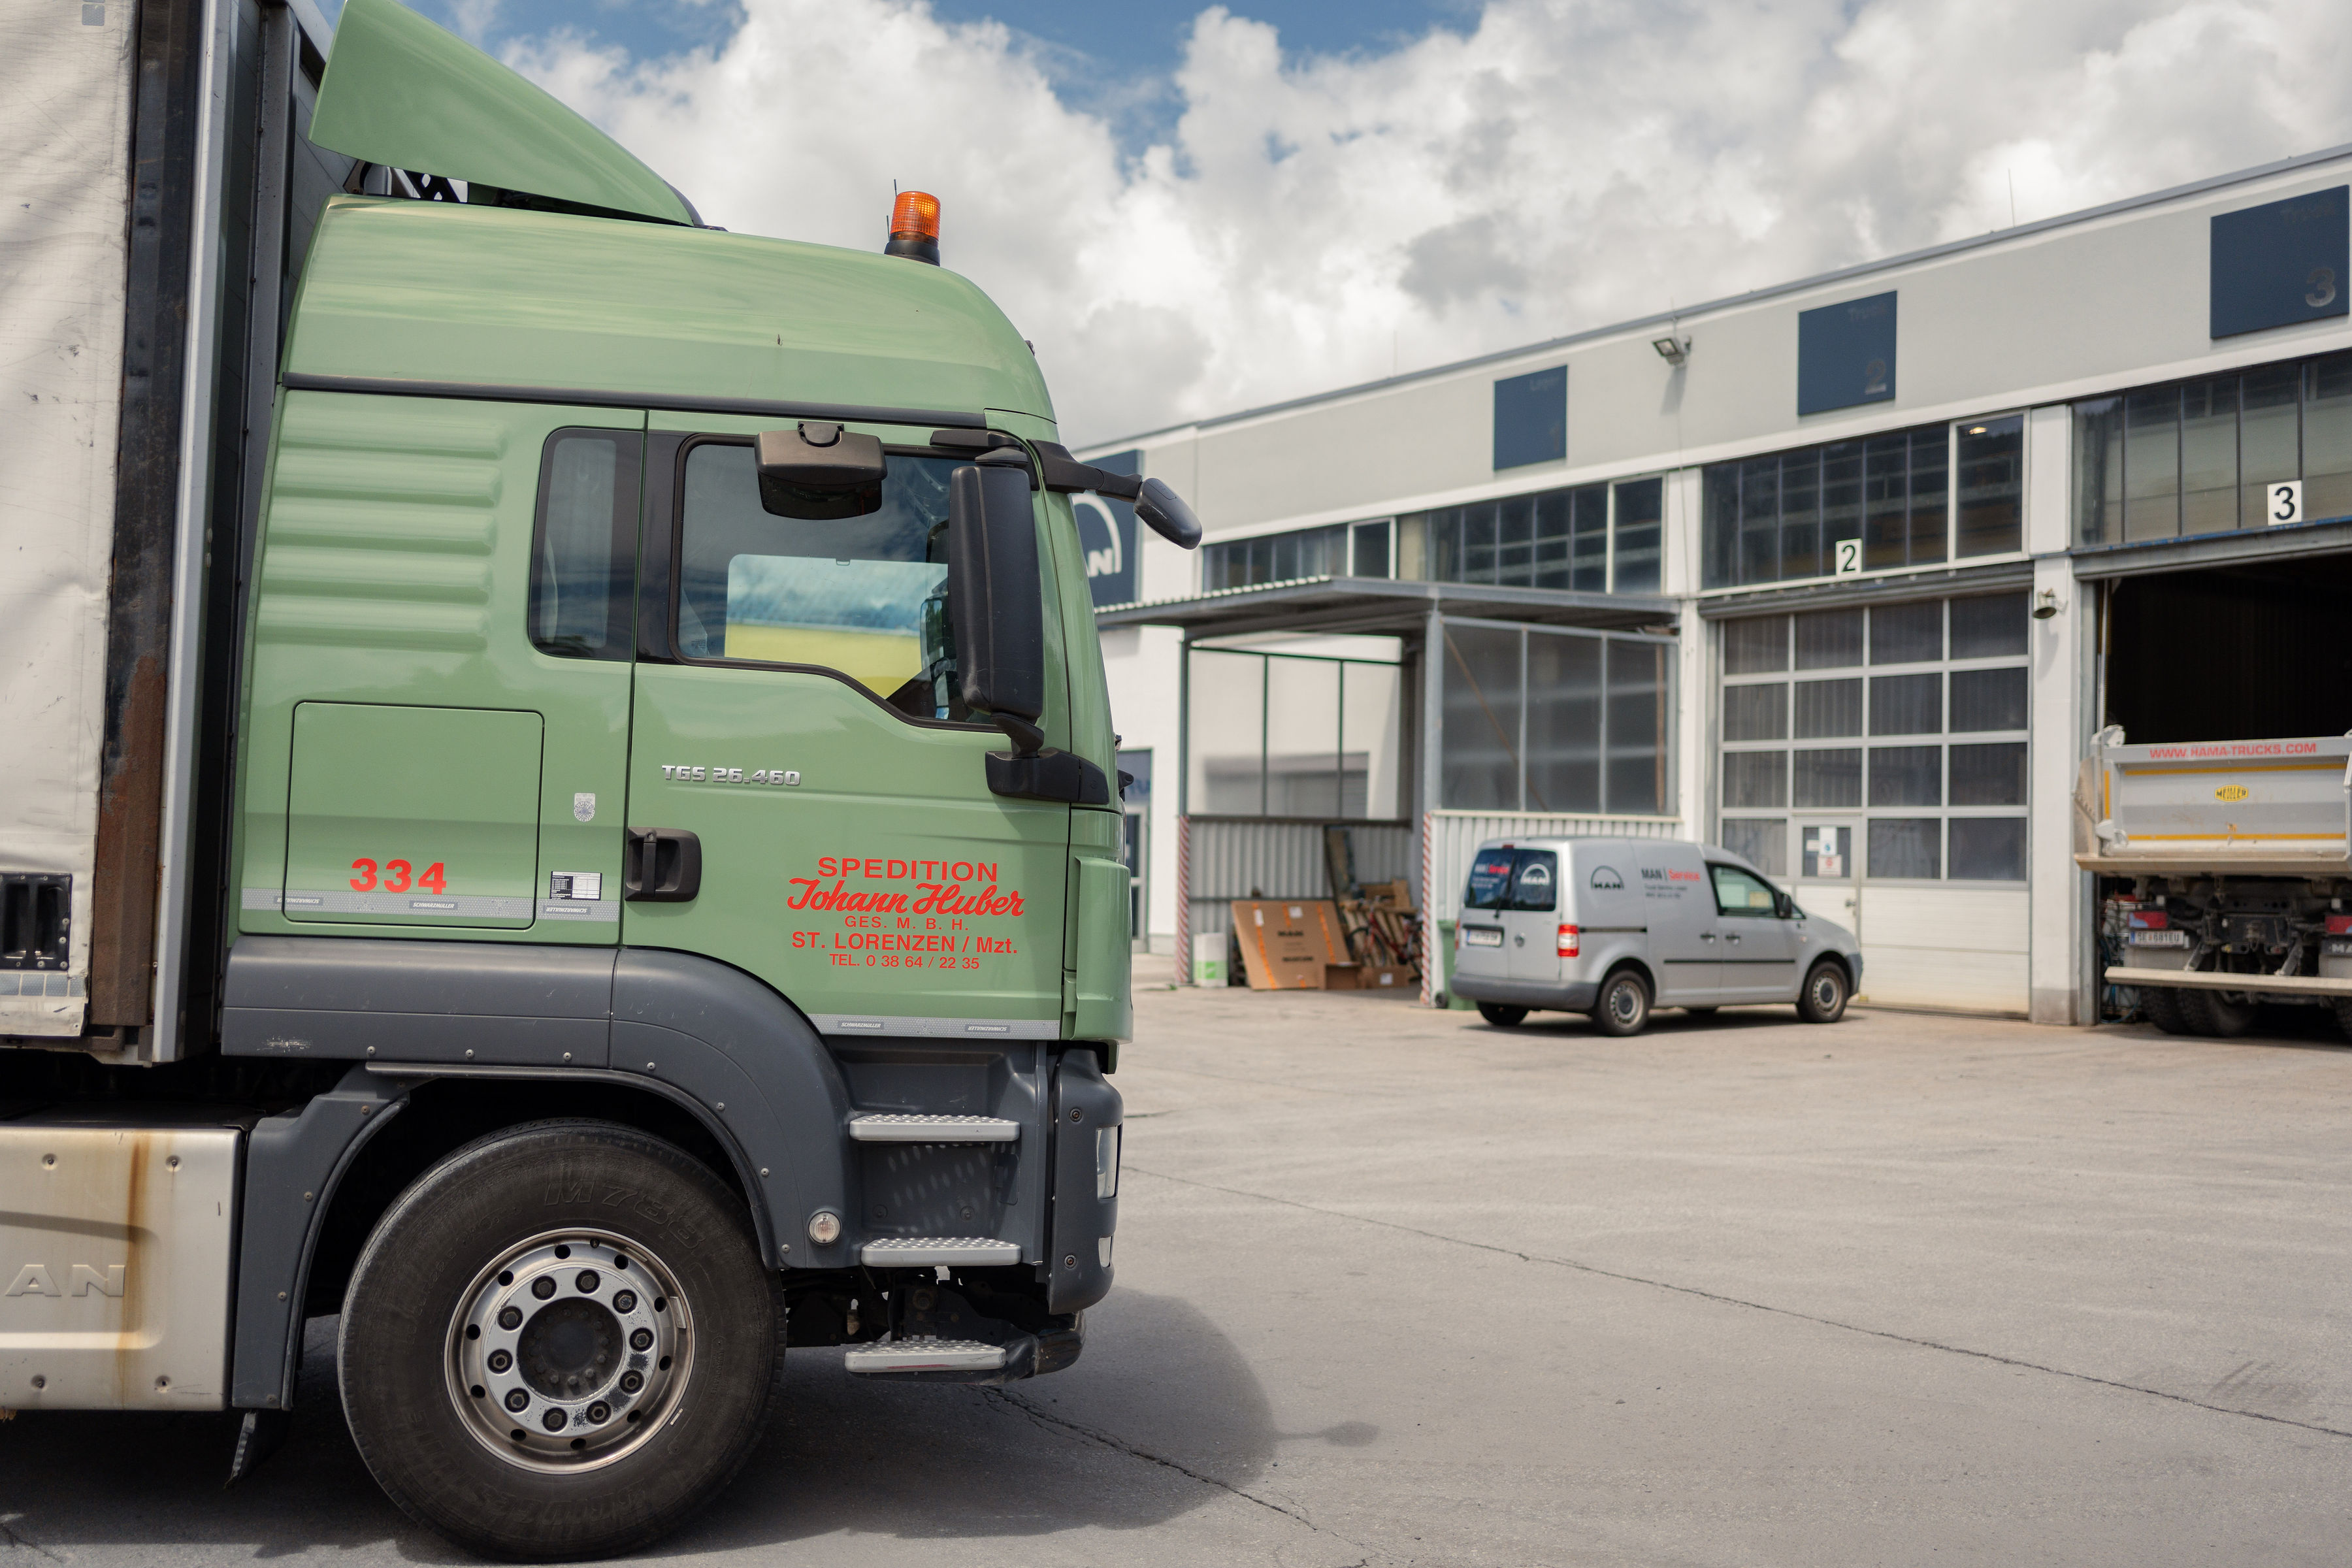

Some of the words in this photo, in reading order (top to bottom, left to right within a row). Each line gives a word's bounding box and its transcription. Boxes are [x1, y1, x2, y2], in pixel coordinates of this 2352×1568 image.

[2305, 267, 2336, 308] 3
[1864, 357, 1887, 395] 2
[2274, 486, 2295, 520] 3
[1842, 545, 1856, 572] 2
[661, 765, 706, 781] TGS
[713, 767, 800, 785] 26.460
[349, 858, 448, 896] 334
[817, 857, 998, 882] SPEDITION
[787, 877, 909, 914] Johann
[911, 883, 1025, 917] Huber
[845, 915, 887, 929] GES.
[897, 917, 916, 930] M.
[926, 918, 942, 930] B.
[951, 919, 968, 931] H.
[792, 931, 826, 949] ST.
[835, 932, 955, 953] LORENZEN
[962, 936, 970, 953] /
[977, 936, 1018, 955] Mzt.
[829, 953, 860, 966] TEL.
[866, 955, 876, 967] 0
[881, 955, 900, 968] 38
[905, 956, 923, 968] 64
[939, 956, 956, 969] 22
[962, 957, 980, 970] 35
